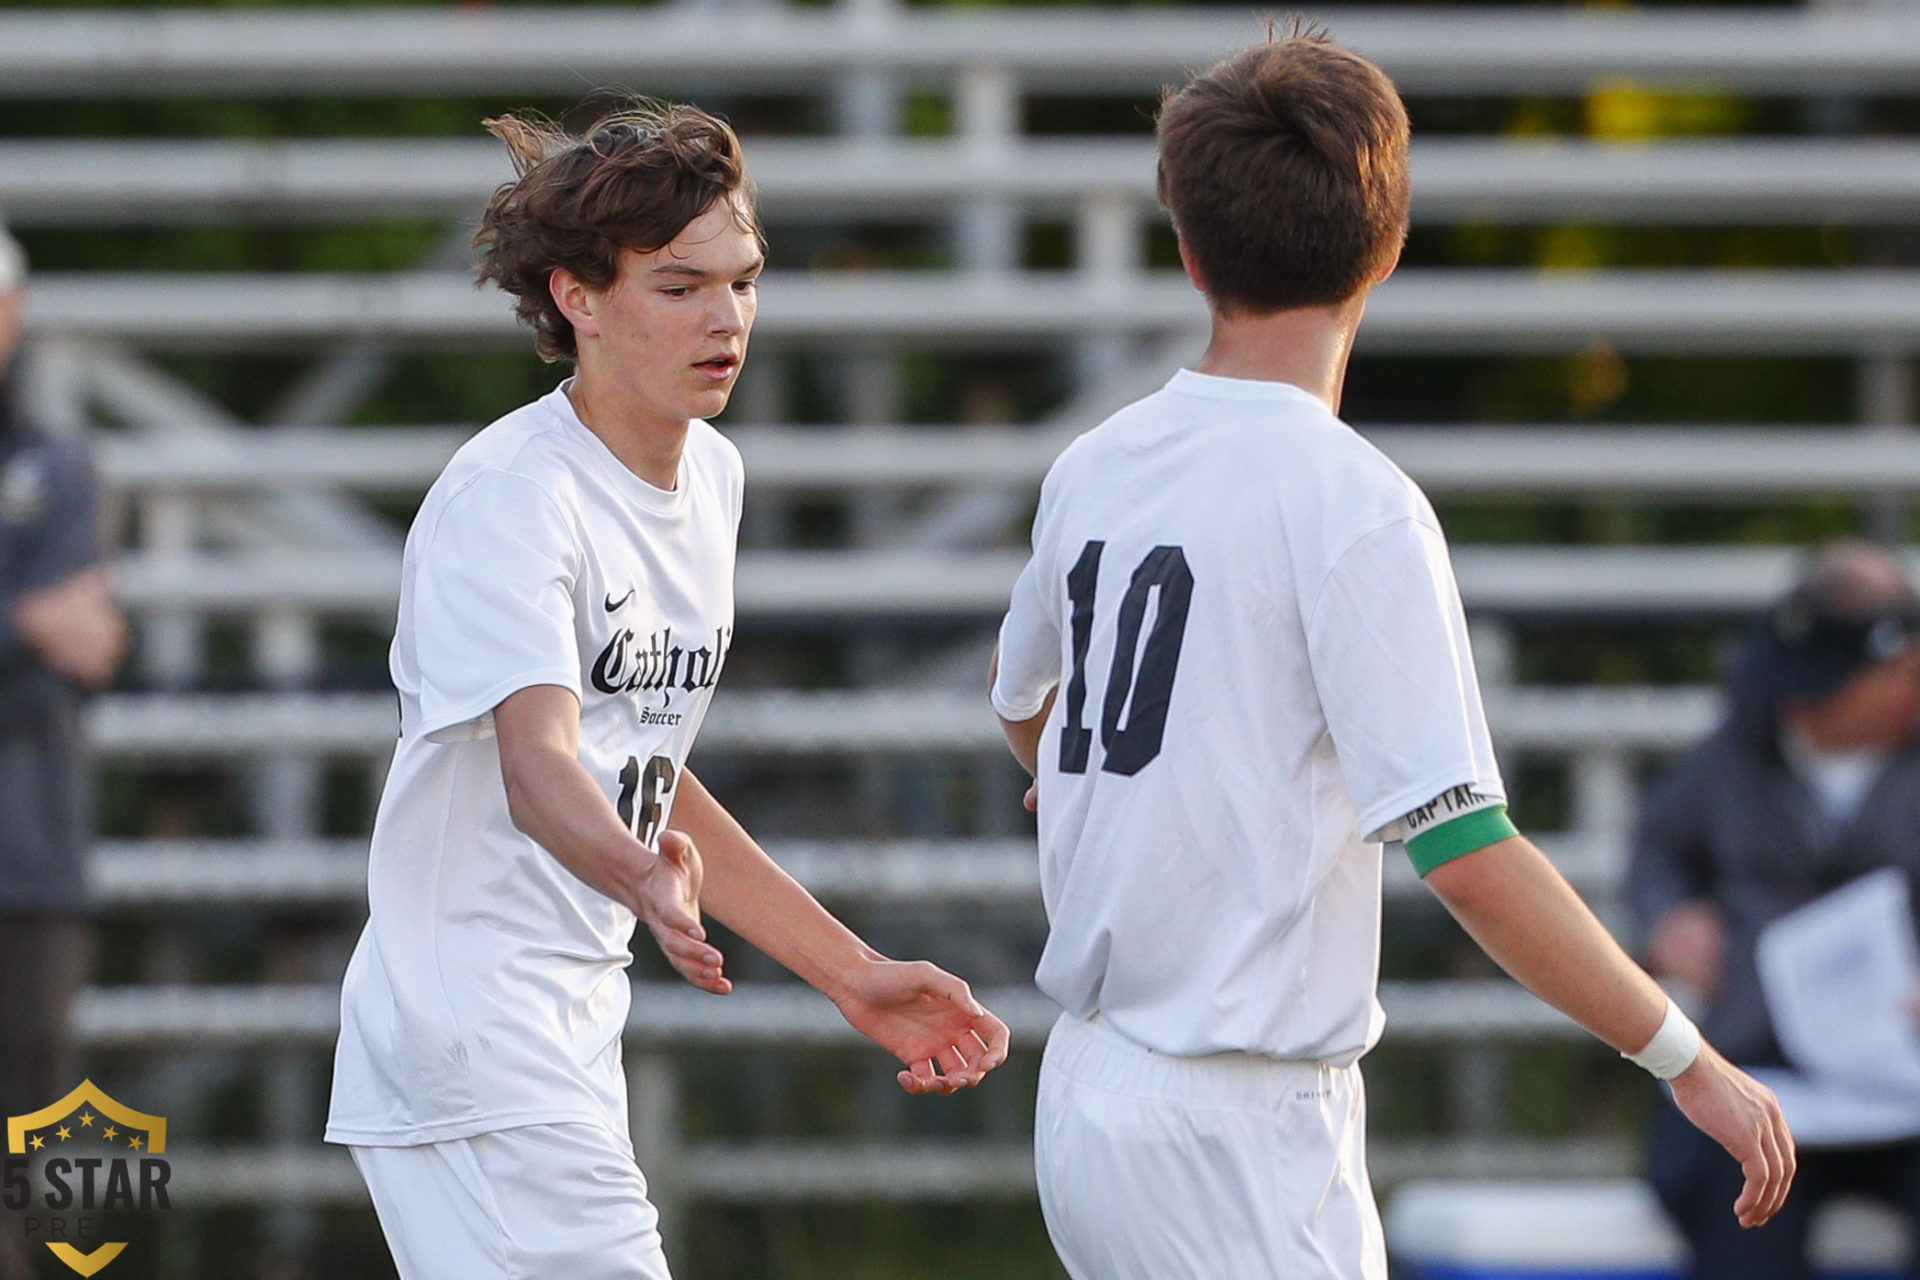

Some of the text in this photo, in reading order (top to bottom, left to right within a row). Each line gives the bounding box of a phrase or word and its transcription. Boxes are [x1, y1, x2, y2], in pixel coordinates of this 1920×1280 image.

[1058, 539, 1195, 777] 10
[640, 706, 682, 726] Soccer
[617, 755, 676, 850] 16
